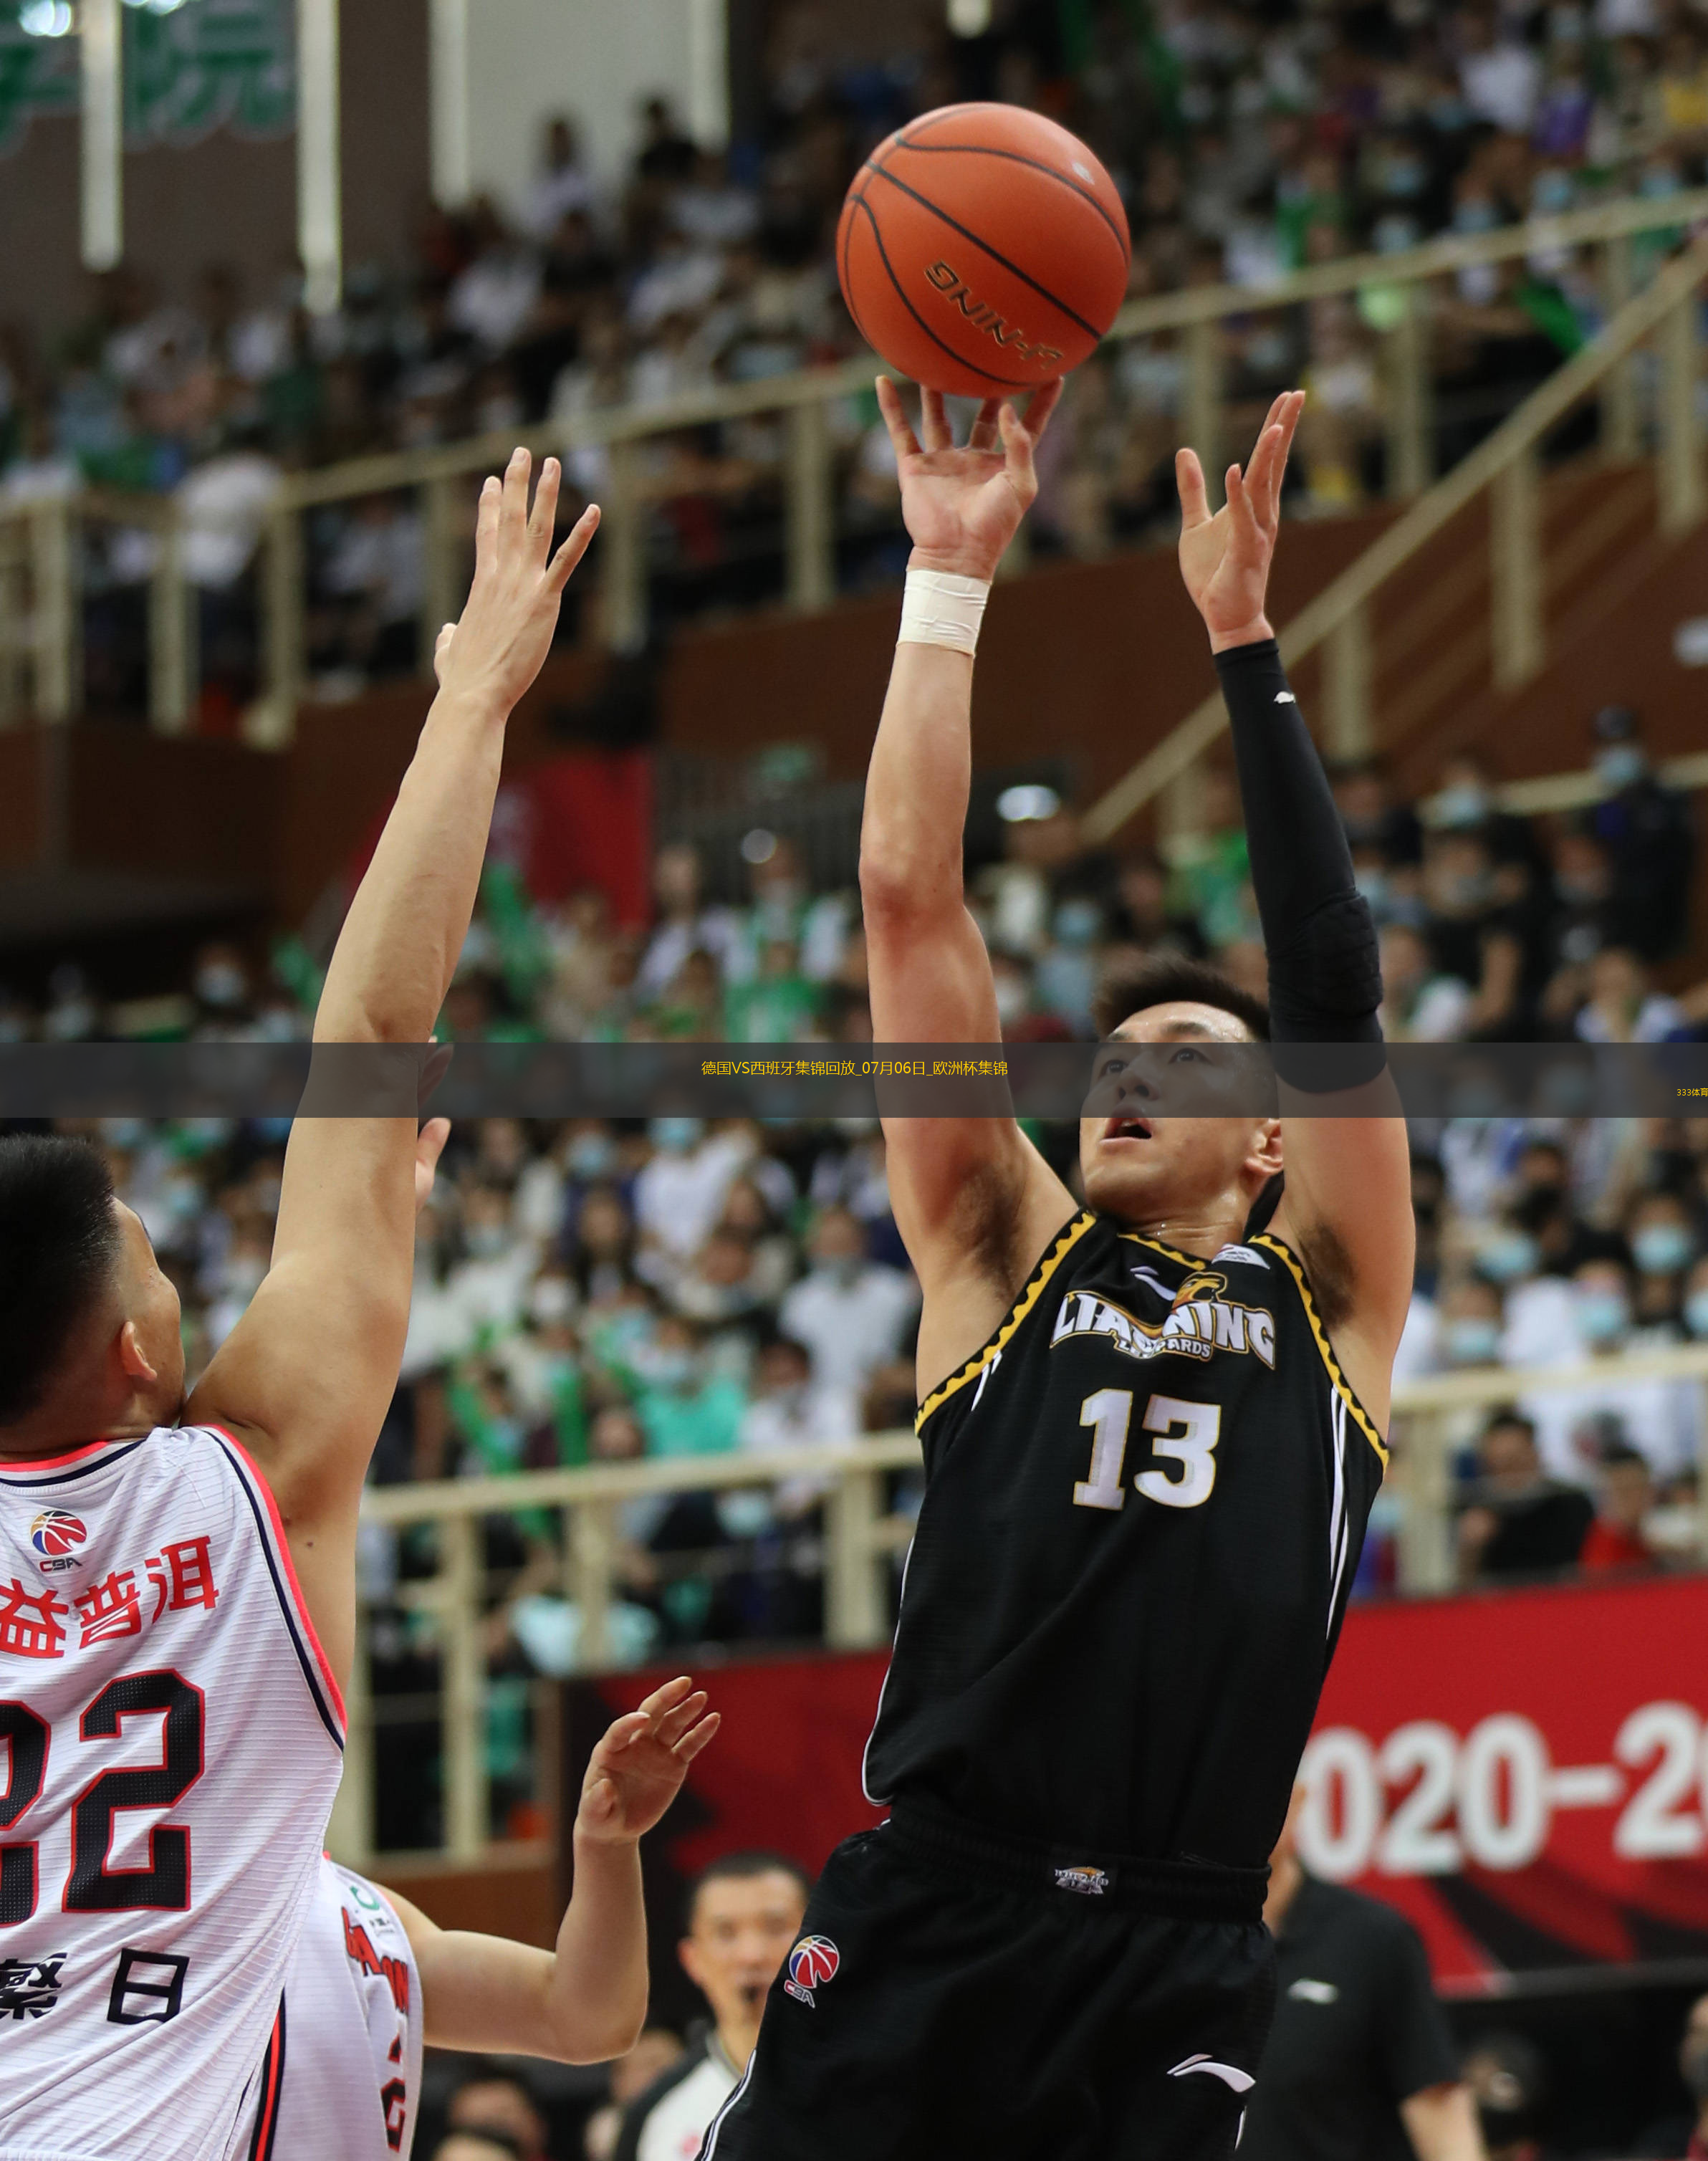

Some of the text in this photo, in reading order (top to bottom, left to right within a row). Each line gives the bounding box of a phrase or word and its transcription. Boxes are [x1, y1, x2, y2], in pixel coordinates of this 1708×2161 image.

[1073, 1388, 1222, 1510] 13
[39, 1557, 83, 1572] CBA
[784, 1979, 815, 2008] CBA
